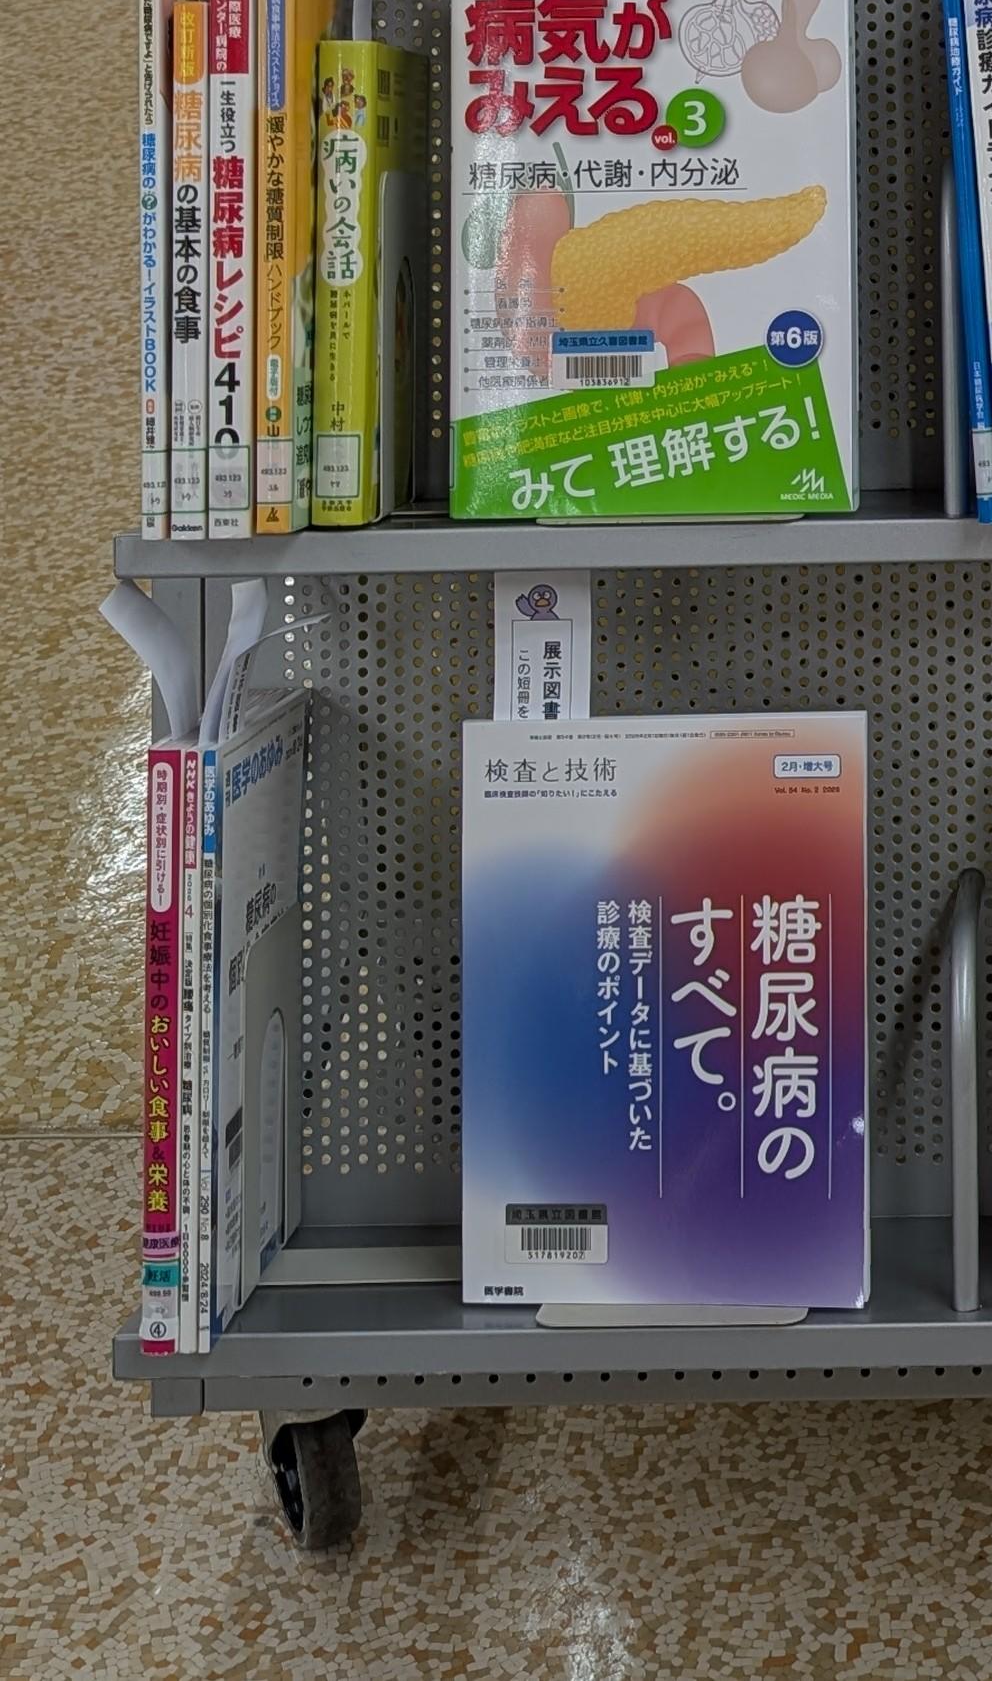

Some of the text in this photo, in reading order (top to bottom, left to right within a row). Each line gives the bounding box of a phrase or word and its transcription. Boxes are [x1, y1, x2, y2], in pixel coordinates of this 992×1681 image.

[180, 11, 196, 78] 改訂新版
[220, 79, 236, 152] 一生役立つ
[464, 67, 660, 137] みえる
[654, 101, 708, 145] vol. 3
[323, 134, 360, 280] 病いの会話
[469, 158, 740, 190] 糖尿病・代謝・内分泌
[173, 90, 202, 344] 糖尿病の基本の食事
[770, 326, 819, 350] 第6版
[512, 454, 596, 511] みて
[780, 492, 834, 501] MEDIC MEDIA
[203, 765, 215, 836] 医学のあゆみ
[484, 756, 617, 784] 検査と技術
[597, 900, 620, 1077] 診療のポイント
[670, 899, 738, 1113] すべて。
[627, 900, 653, 1152] 検査データに基づいた
[749, 894, 822, 1180] 糖尿病の
[484, 1285, 524, 1296] 医学書院
